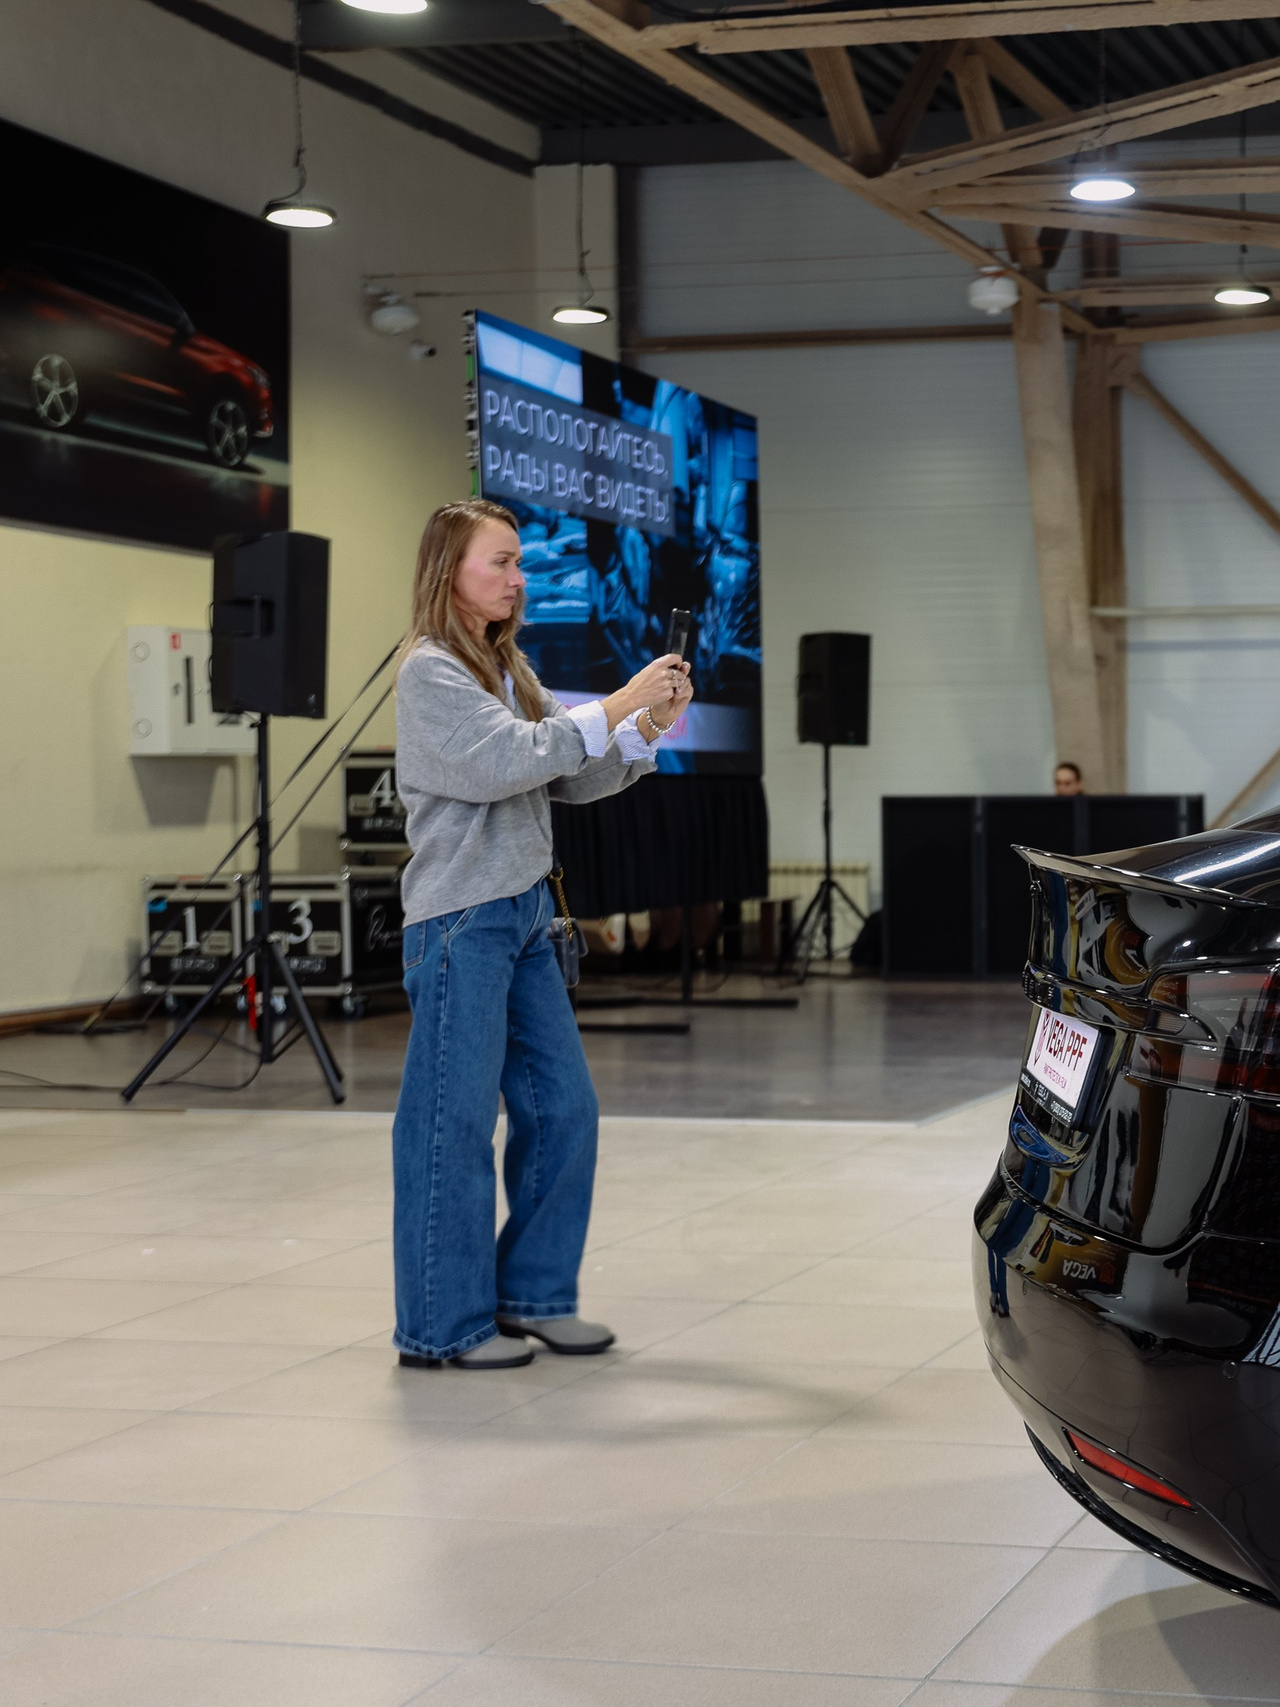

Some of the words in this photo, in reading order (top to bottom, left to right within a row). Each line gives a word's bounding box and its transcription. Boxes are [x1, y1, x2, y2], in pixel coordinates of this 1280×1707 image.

[484, 389, 669, 481] РАСПОЛОГАЙТЕСЬ,
[487, 444, 549, 495] РАДЫ
[553, 463, 594, 505] ВАС
[369, 768, 396, 808] 4
[182, 906, 200, 949] 1
[288, 900, 313, 944] 3
[1045, 1016, 1068, 1063] VEGA
[1062, 1029, 1088, 1071] PPF
